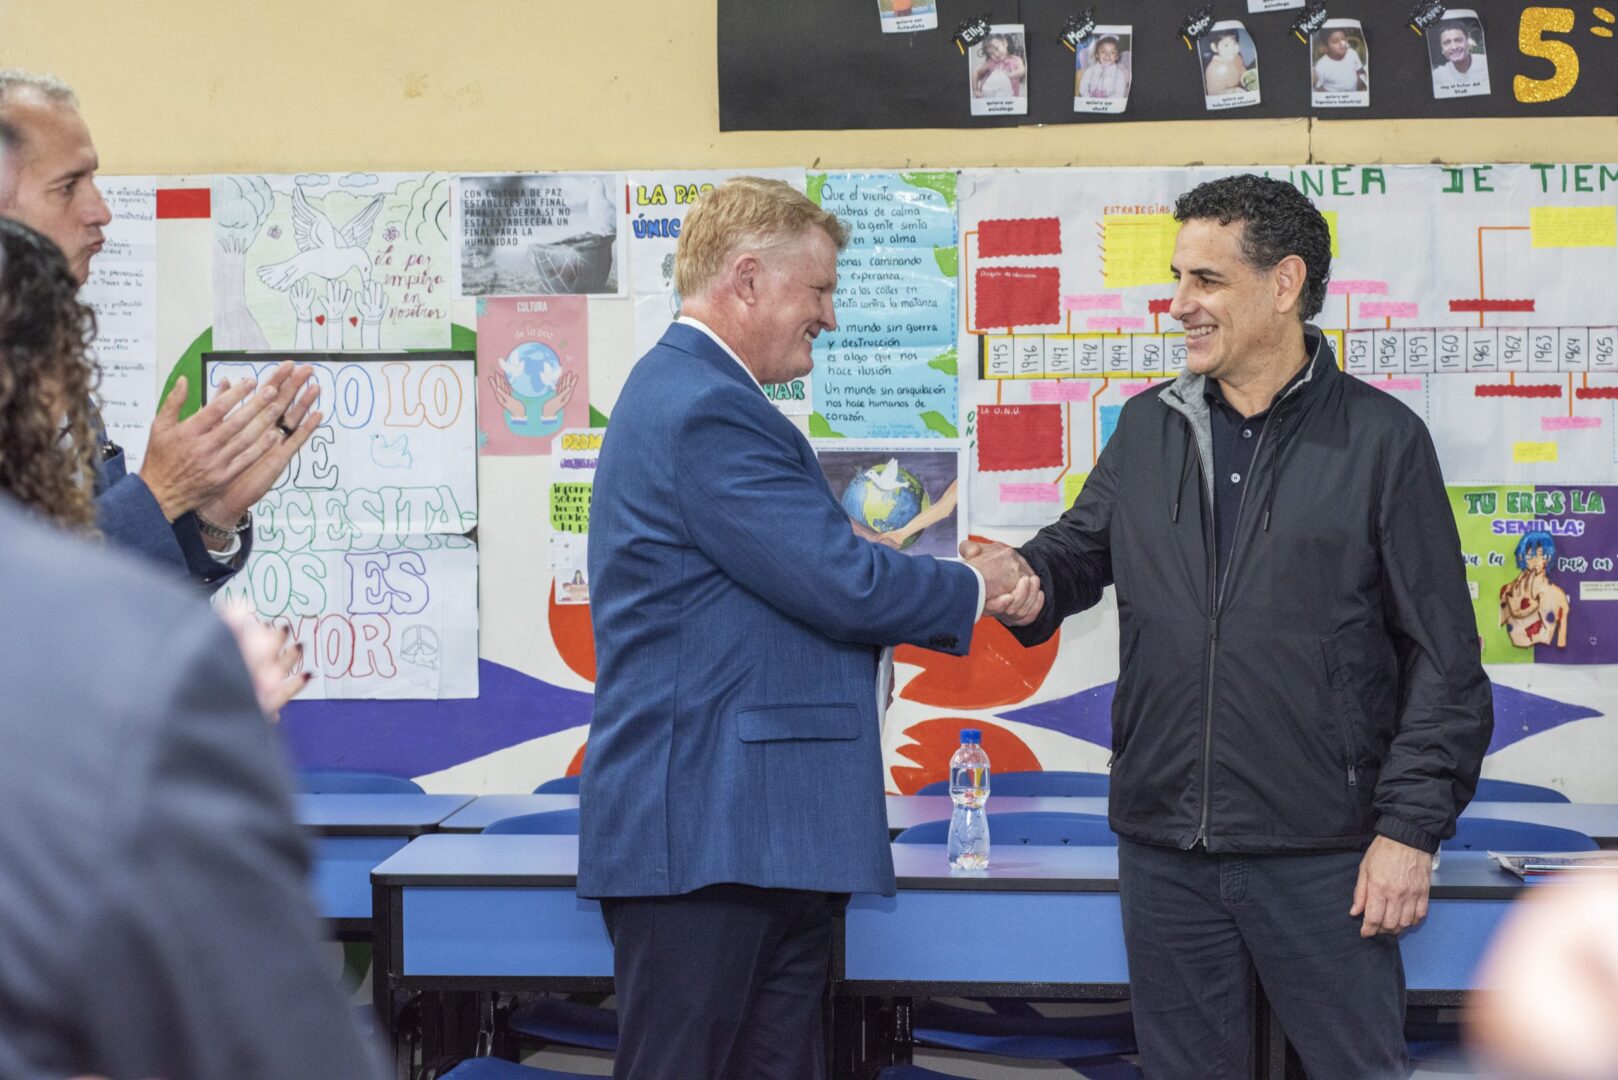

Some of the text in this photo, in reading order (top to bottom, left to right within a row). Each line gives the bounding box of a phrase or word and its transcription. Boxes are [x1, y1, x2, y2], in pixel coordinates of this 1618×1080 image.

[962, 25, 985, 42] Elly
[1513, 7, 1580, 103] 5
[820, 183, 846, 201] Que
[849, 184, 858, 201] el
[862, 186, 893, 201] viento
[1264, 168, 1386, 196] INEA
[1441, 166, 1494, 193] DE
[464, 188, 563, 198] CON CULTURA DE PAZ
[464, 198, 567, 209] ESTABLECES UN FINAL
[637, 184, 667, 206] LA
[464, 209, 489, 218] PARA
[491, 209, 503, 217] LA
[558, 207, 571, 217] NO
[556, 218, 569, 226] UN
[874, 206, 886, 217] de
[891, 205, 921, 217] calma
[464, 227, 533, 237] FINAL PARA LA
[464, 237, 519, 247] HUMANIDAD
[853, 233, 917, 245] en su alma
[870, 256, 921, 267] caminando
[876, 286, 899, 295] calles
[516, 301, 548, 313] CULTURA
[901, 297, 938, 308] matanza
[846, 322, 882, 333] mundo
[887, 323, 903, 333] sin
[906, 323, 938, 334] guerra
[828, 340, 835, 349] y
[1349, 339, 1368, 368] 1957
[1380, 336, 1398, 368] 1958
[1409, 336, 1429, 367] 1959
[1440, 334, 1460, 367] 1960
[1472, 340, 1495, 367] 1961
[1503, 335, 1522, 363] 1962
[1534, 335, 1553, 363] 1963
[1565, 338, 1582, 363] 1964
[1595, 336, 1614, 365] 1965
[827, 352, 918, 364] es algo que nos
[992, 345, 1008, 373] 1945
[1021, 344, 1038, 372] 1946
[1051, 347, 1069, 371] 1947
[1080, 343, 1097, 371] 1948
[1111, 345, 1127, 371] 1949
[1143, 344, 1159, 370] 1950
[828, 365, 852, 376] hace
[211, 361, 462, 429] TDO LO
[824, 382, 841, 394] Un
[845, 385, 877, 395] mundo
[881, 384, 894, 395] sin
[846, 398, 865, 408] hace
[869, 398, 909, 408] humanos
[915, 398, 926, 408] de
[1464, 489, 1605, 515] TU ERES LA
[250, 486, 478, 552] ECESITA-
[1488, 552, 1505, 566] la
[345, 551, 430, 614] ES
[262, 613, 397, 680] MOR
